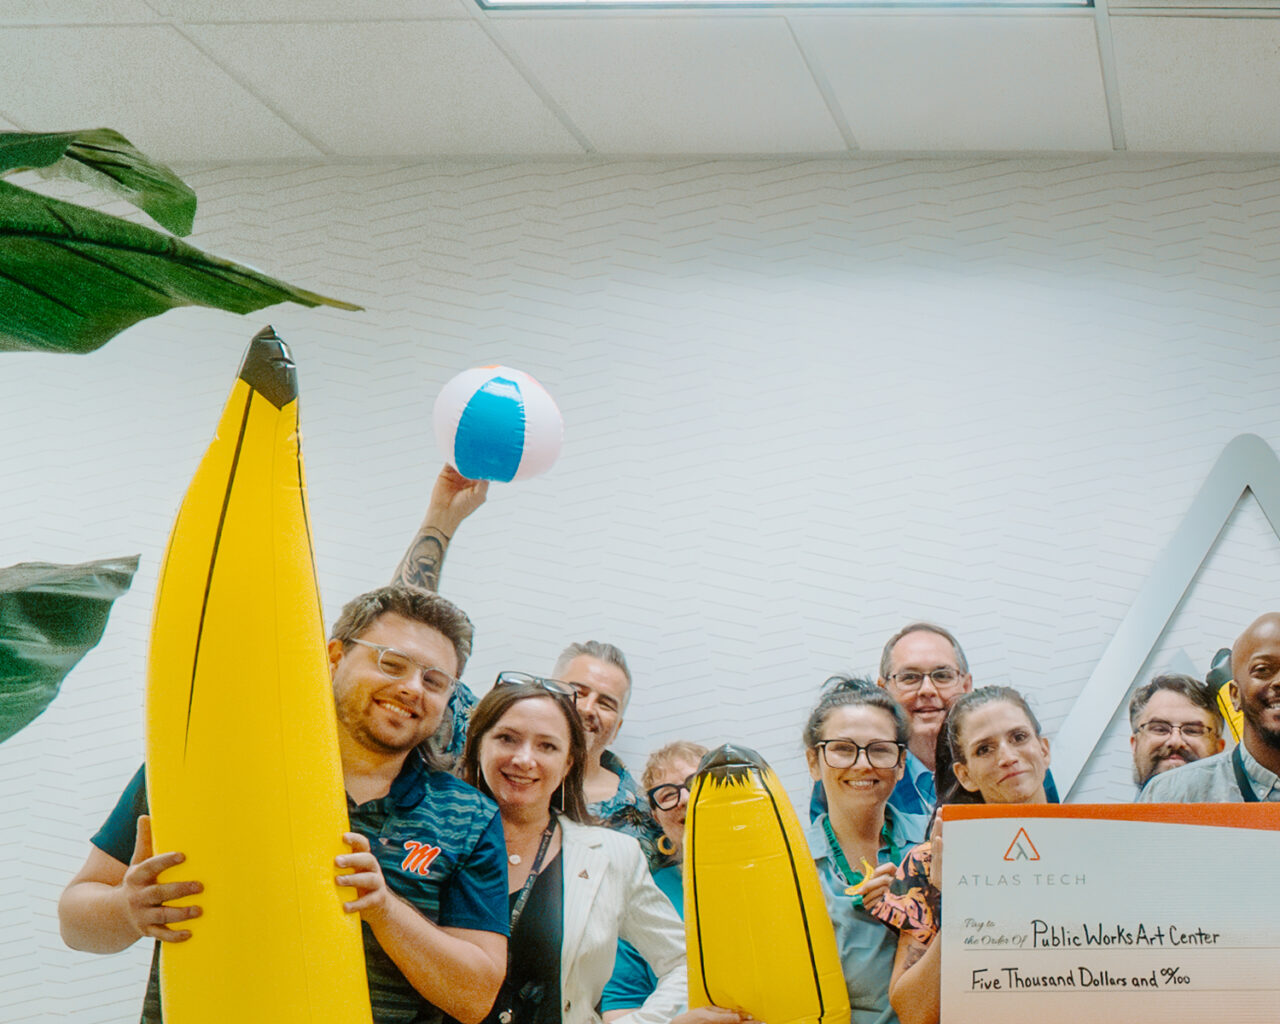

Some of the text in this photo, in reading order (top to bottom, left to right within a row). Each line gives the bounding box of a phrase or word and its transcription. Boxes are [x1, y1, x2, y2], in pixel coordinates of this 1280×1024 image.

[958, 873, 1086, 886] ATLAS TECH
[1031, 919, 1220, 948] Public Works Art Center
[972, 968, 1002, 990] Five
[1001, 967, 1076, 989] Thousand
[1077, 966, 1128, 987] Dollars
[1131, 970, 1158, 988] and
